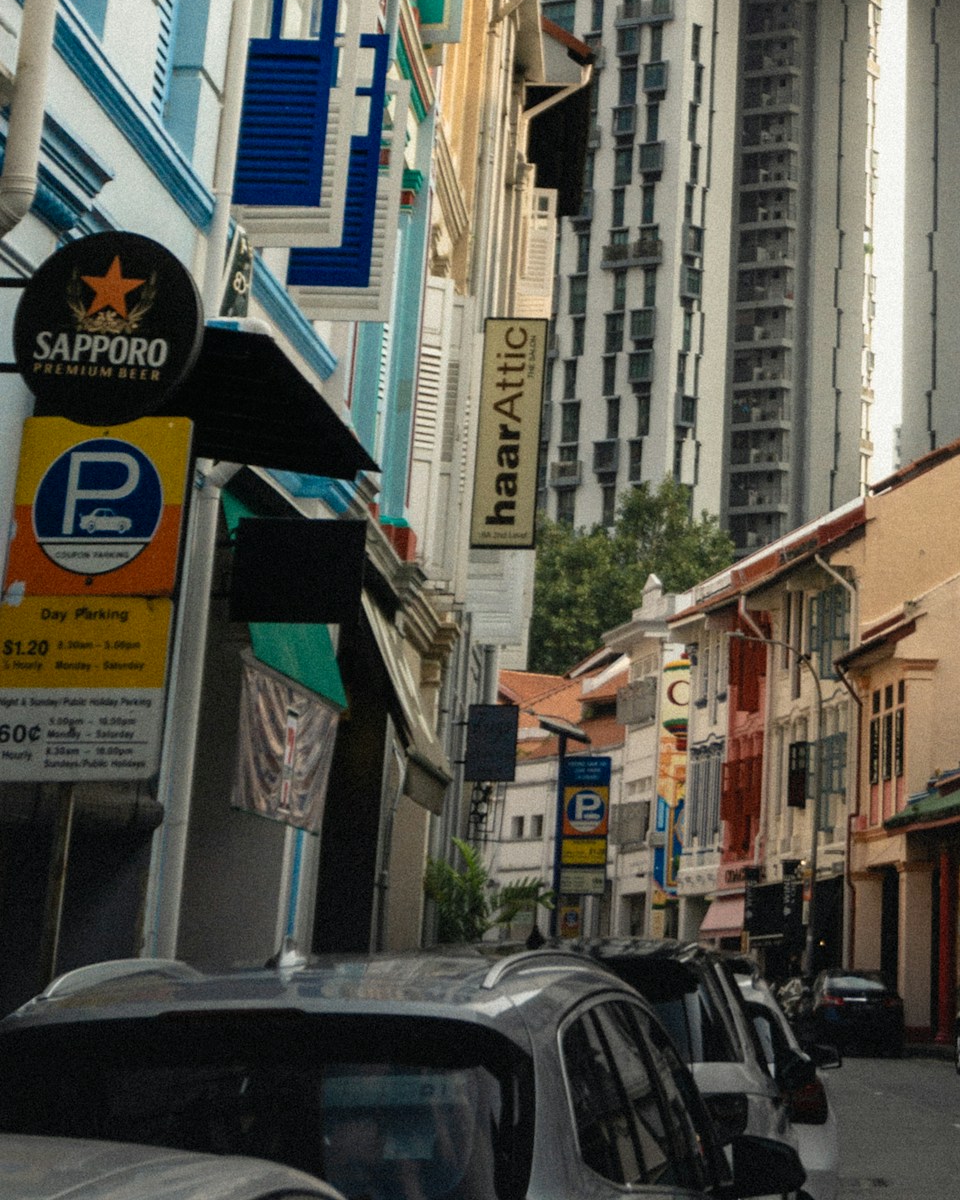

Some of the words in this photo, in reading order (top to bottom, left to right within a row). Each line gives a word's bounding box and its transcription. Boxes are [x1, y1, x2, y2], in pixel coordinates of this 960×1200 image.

[33, 330, 168, 368] SAPPORO
[32, 361, 113, 378] PREMIUM
[117, 367, 161, 381] BEER
[62, 451, 141, 535] P
[41, 608, 68, 623] Day
[74, 607, 130, 623] Parking
[3, 639, 49, 656] $1.20
[575, 793, 601, 820] P
